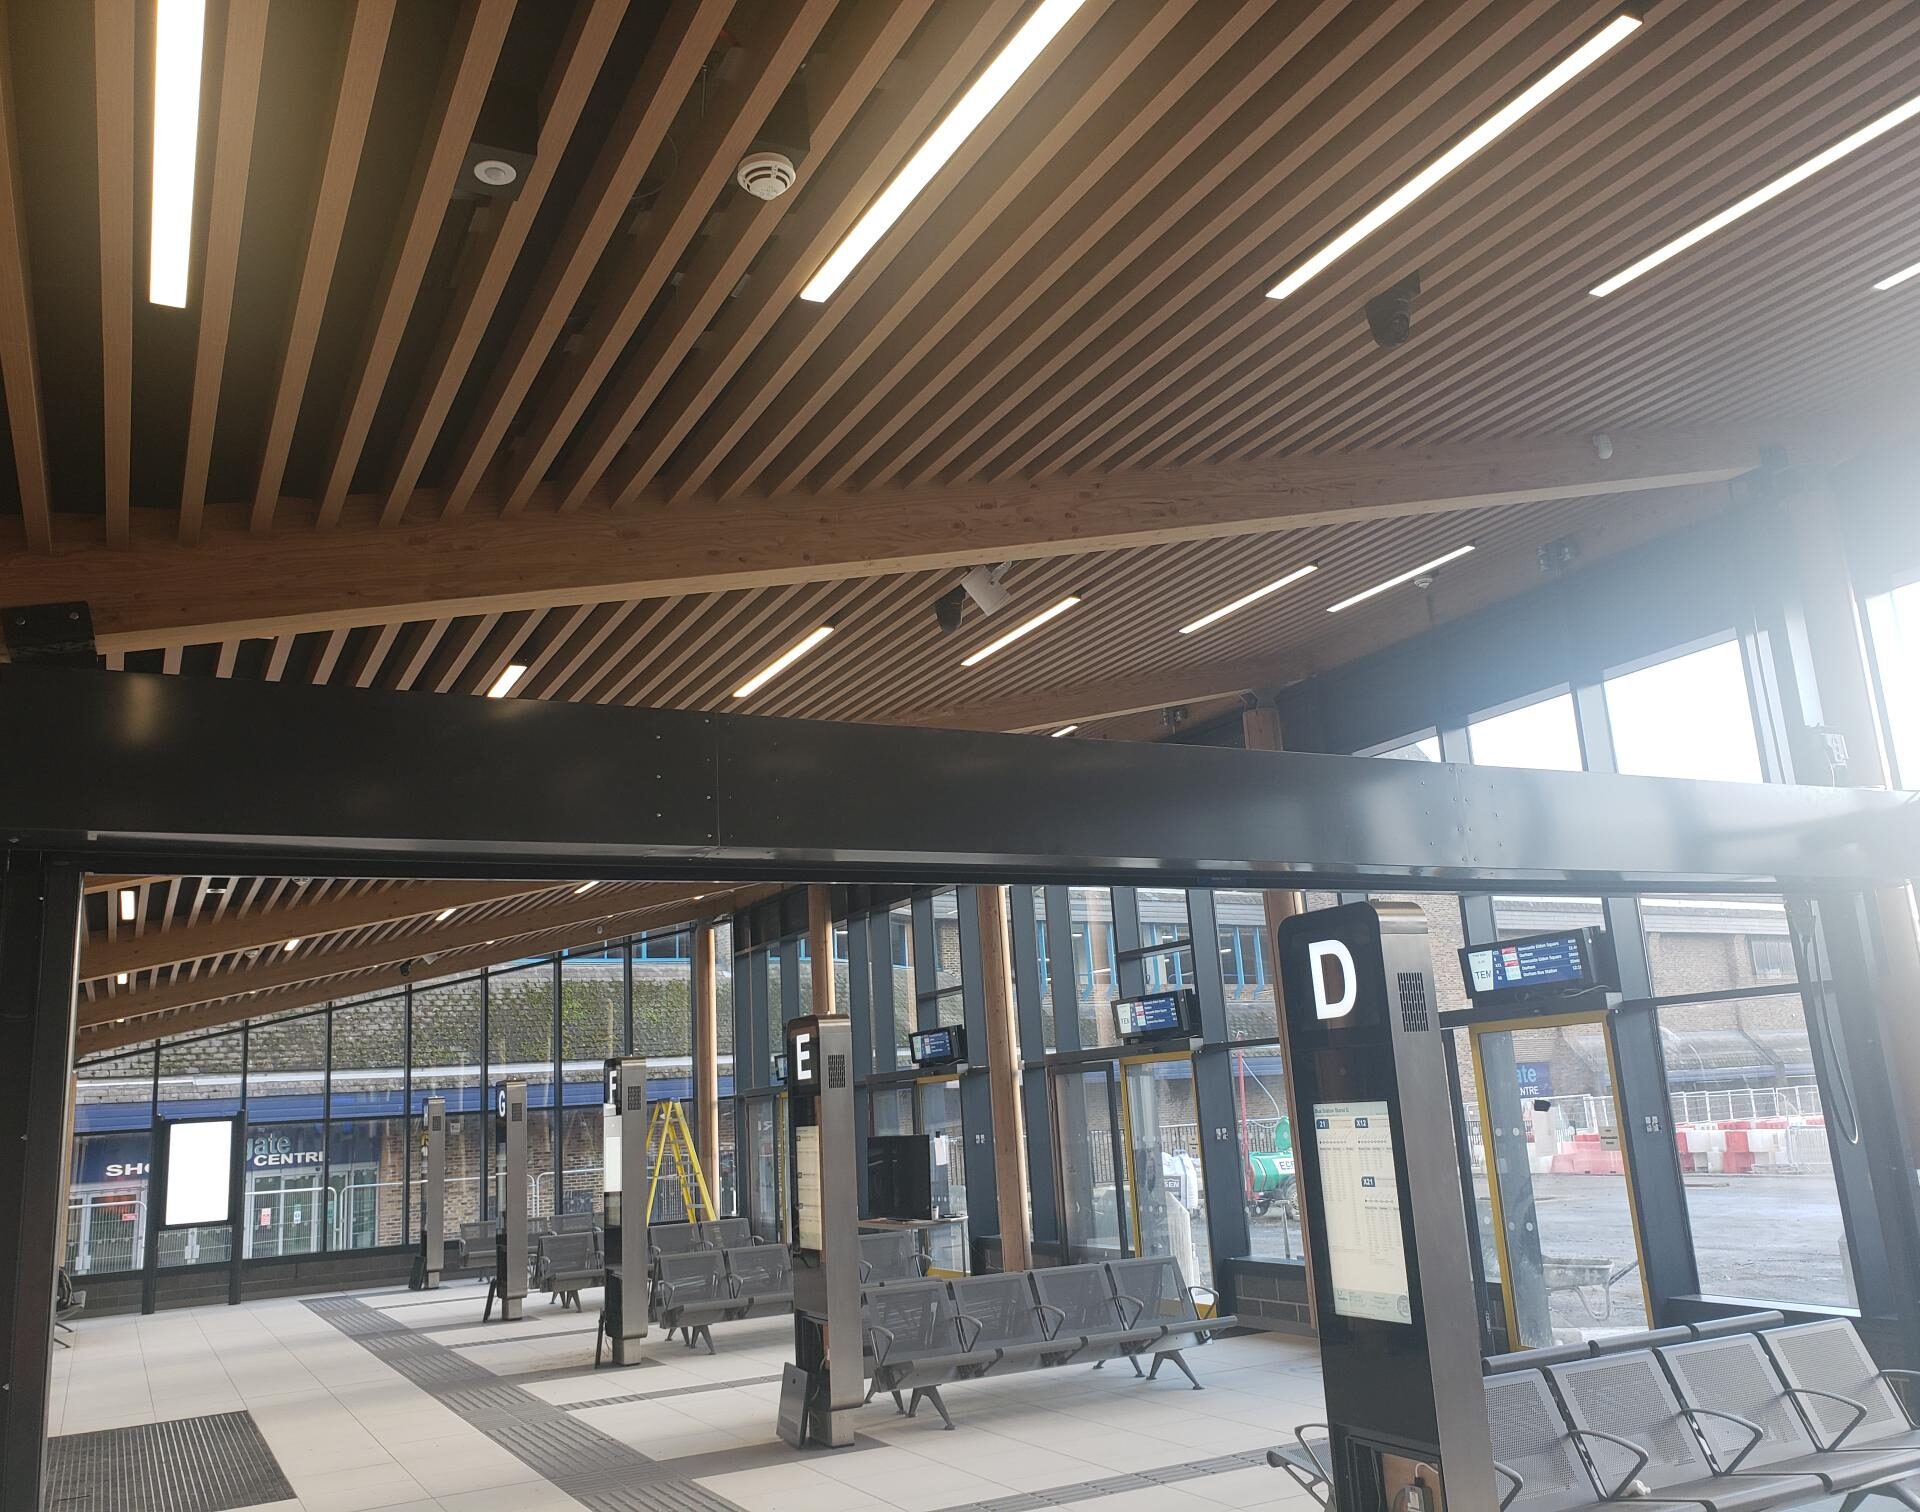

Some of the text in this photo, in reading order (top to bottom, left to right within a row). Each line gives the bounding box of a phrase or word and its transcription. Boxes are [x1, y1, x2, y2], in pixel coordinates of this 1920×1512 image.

[1308, 939, 1357, 1020] D
[796, 1033, 812, 1081] E
[609, 1070, 617, 1104] F
[498, 1090, 506, 1118] G
[1319, 1120, 1327, 1128] 21
[1355, 1119, 1367, 1127] X12
[105, 1162, 150, 1177] SH
